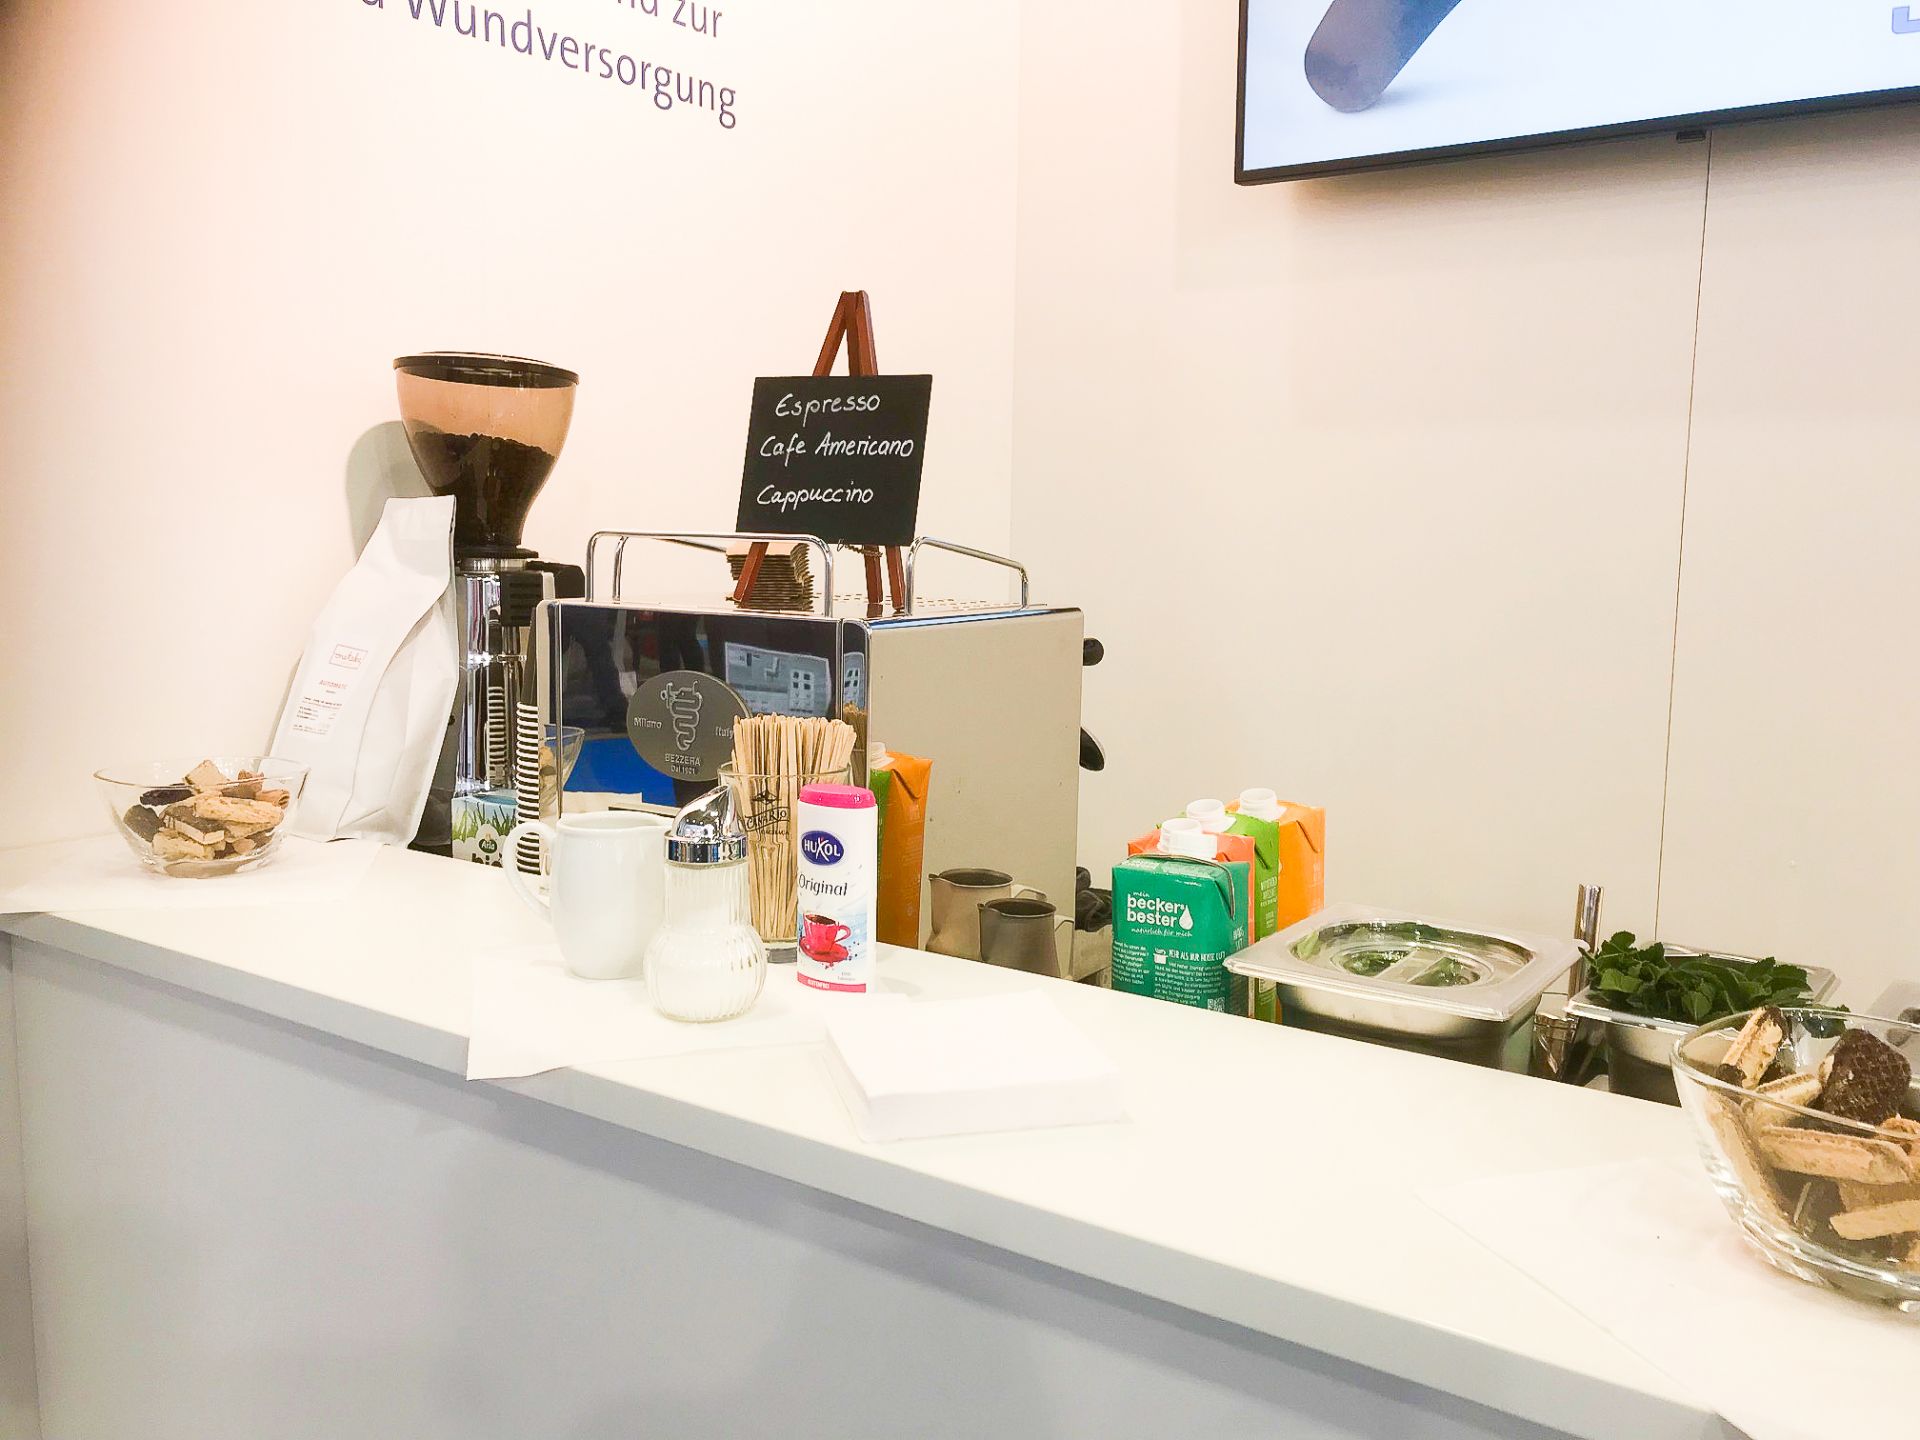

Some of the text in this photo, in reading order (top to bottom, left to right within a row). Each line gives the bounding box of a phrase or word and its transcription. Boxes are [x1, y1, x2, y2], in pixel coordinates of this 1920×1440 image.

[673, 0, 723, 38] zur
[775, 393, 881, 428] Espresso
[759, 431, 914, 467] Cafe Americano
[756, 480, 874, 513] Cappuccino
[664, 753, 701, 766] BEZZERA
[804, 836, 841, 862] HUXOL
[799, 873, 848, 897] Original
[1126, 907, 1178, 928] bester
